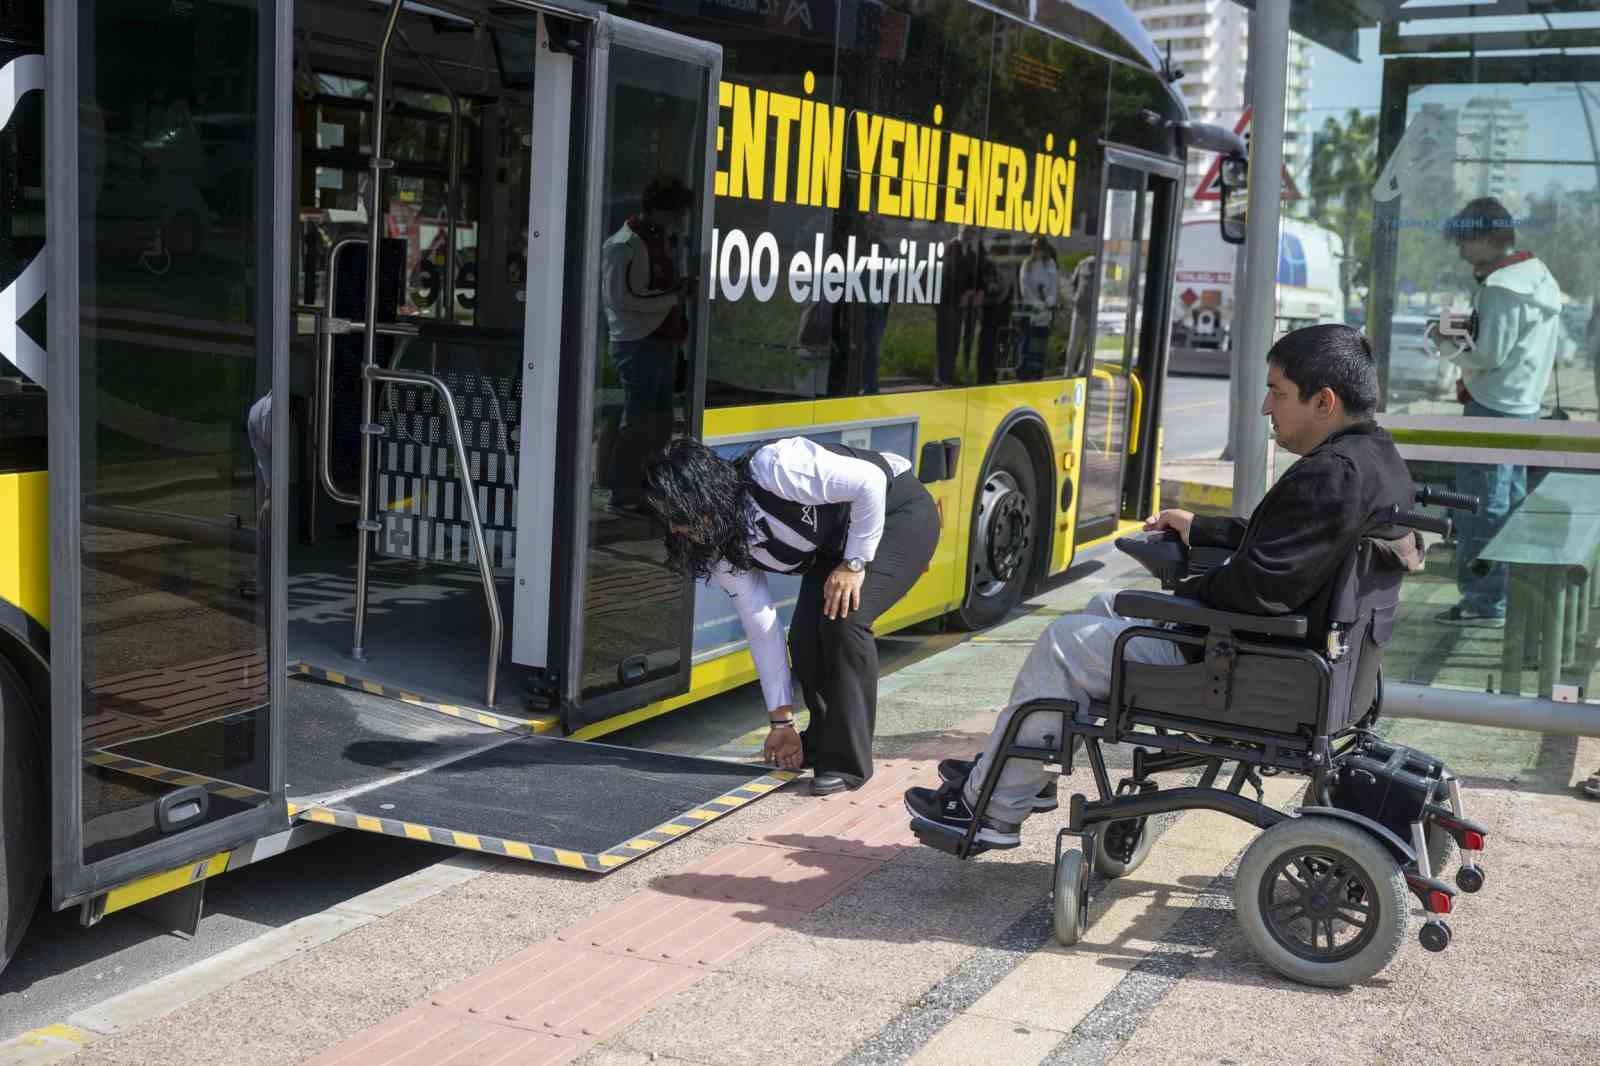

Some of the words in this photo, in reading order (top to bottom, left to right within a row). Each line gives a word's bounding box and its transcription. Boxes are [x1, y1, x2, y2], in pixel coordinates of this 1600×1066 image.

[856, 104, 943, 221] YENİ
[944, 133, 1077, 238] ENERJİSİ
[788, 232, 945, 304] elektrikli
